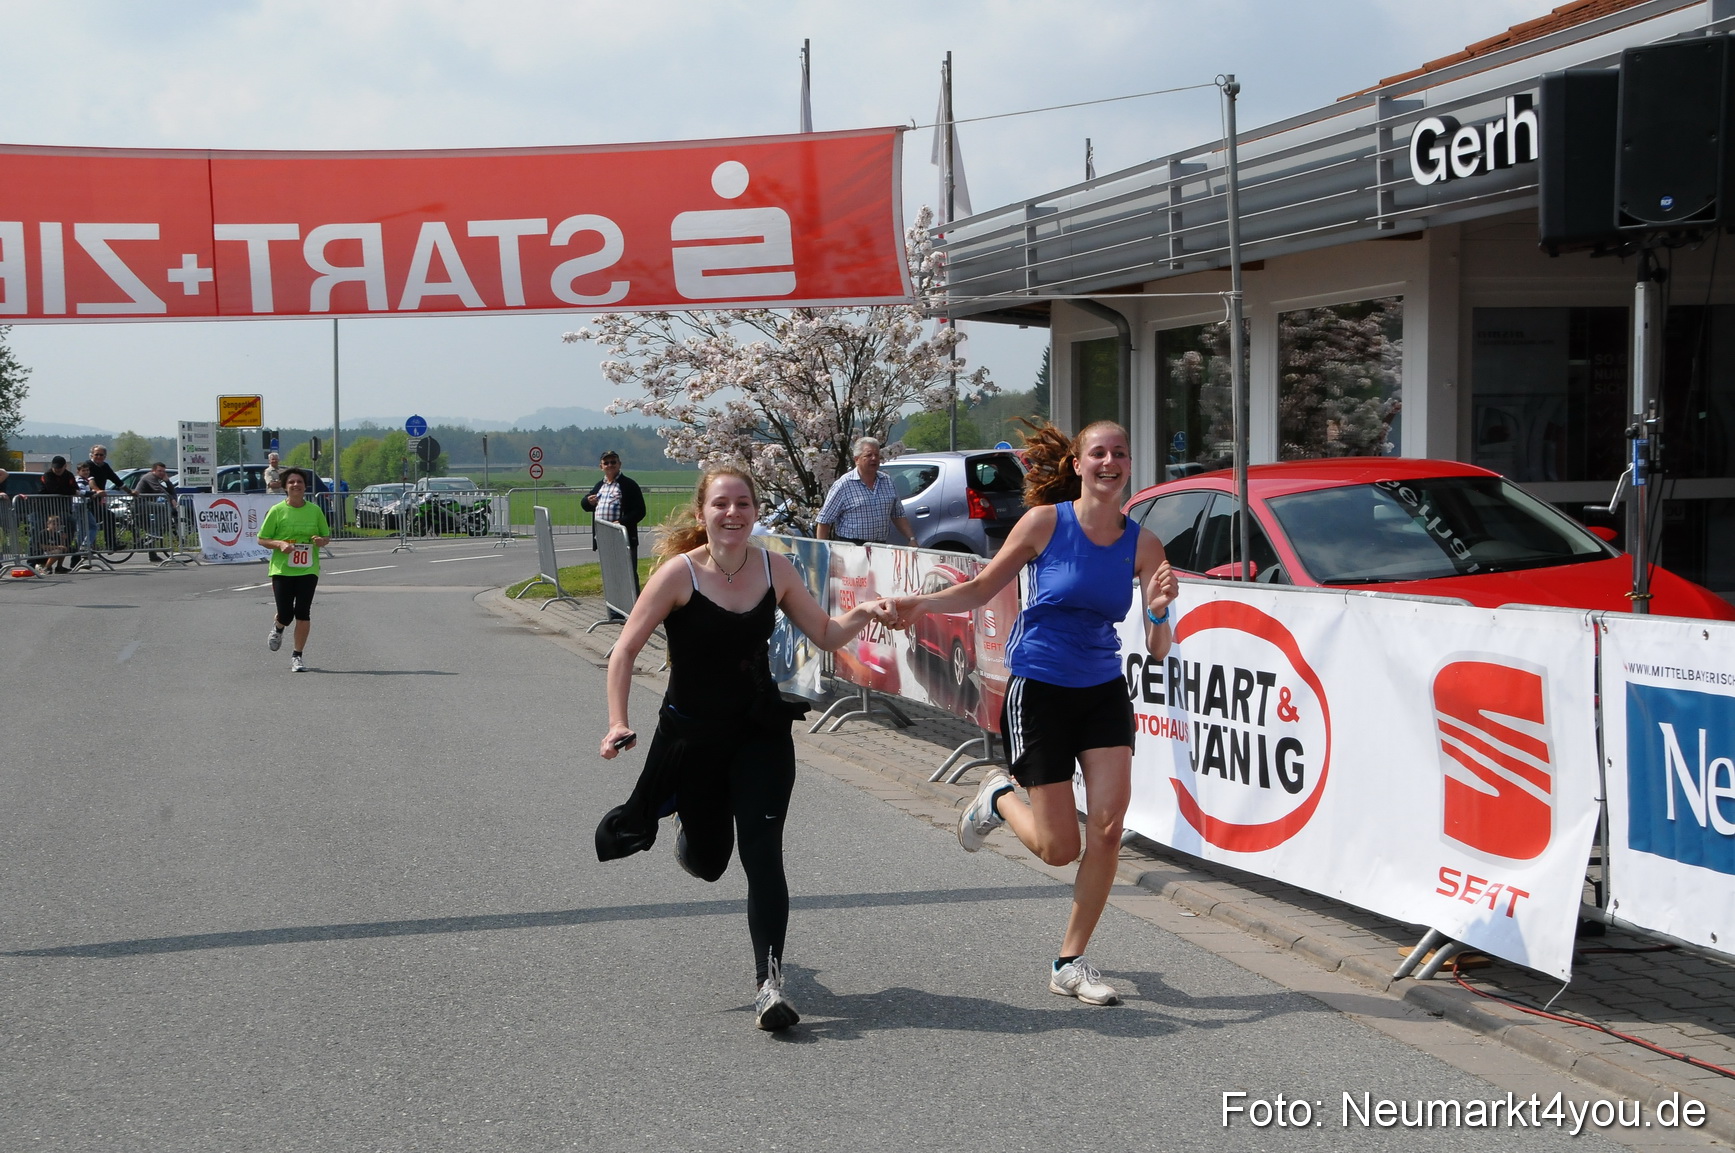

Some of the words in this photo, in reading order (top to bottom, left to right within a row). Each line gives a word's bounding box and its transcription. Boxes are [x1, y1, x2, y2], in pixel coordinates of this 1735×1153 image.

[1410, 94, 1539, 186] Gerh
[199, 511, 233, 523] GERHART
[293, 551, 308, 565] 80
[1126, 652, 1277, 727] GERHART
[1276, 686, 1300, 723] &
[1188, 720, 1305, 795] JÄNIG
[1436, 866, 1530, 919] SEAT
